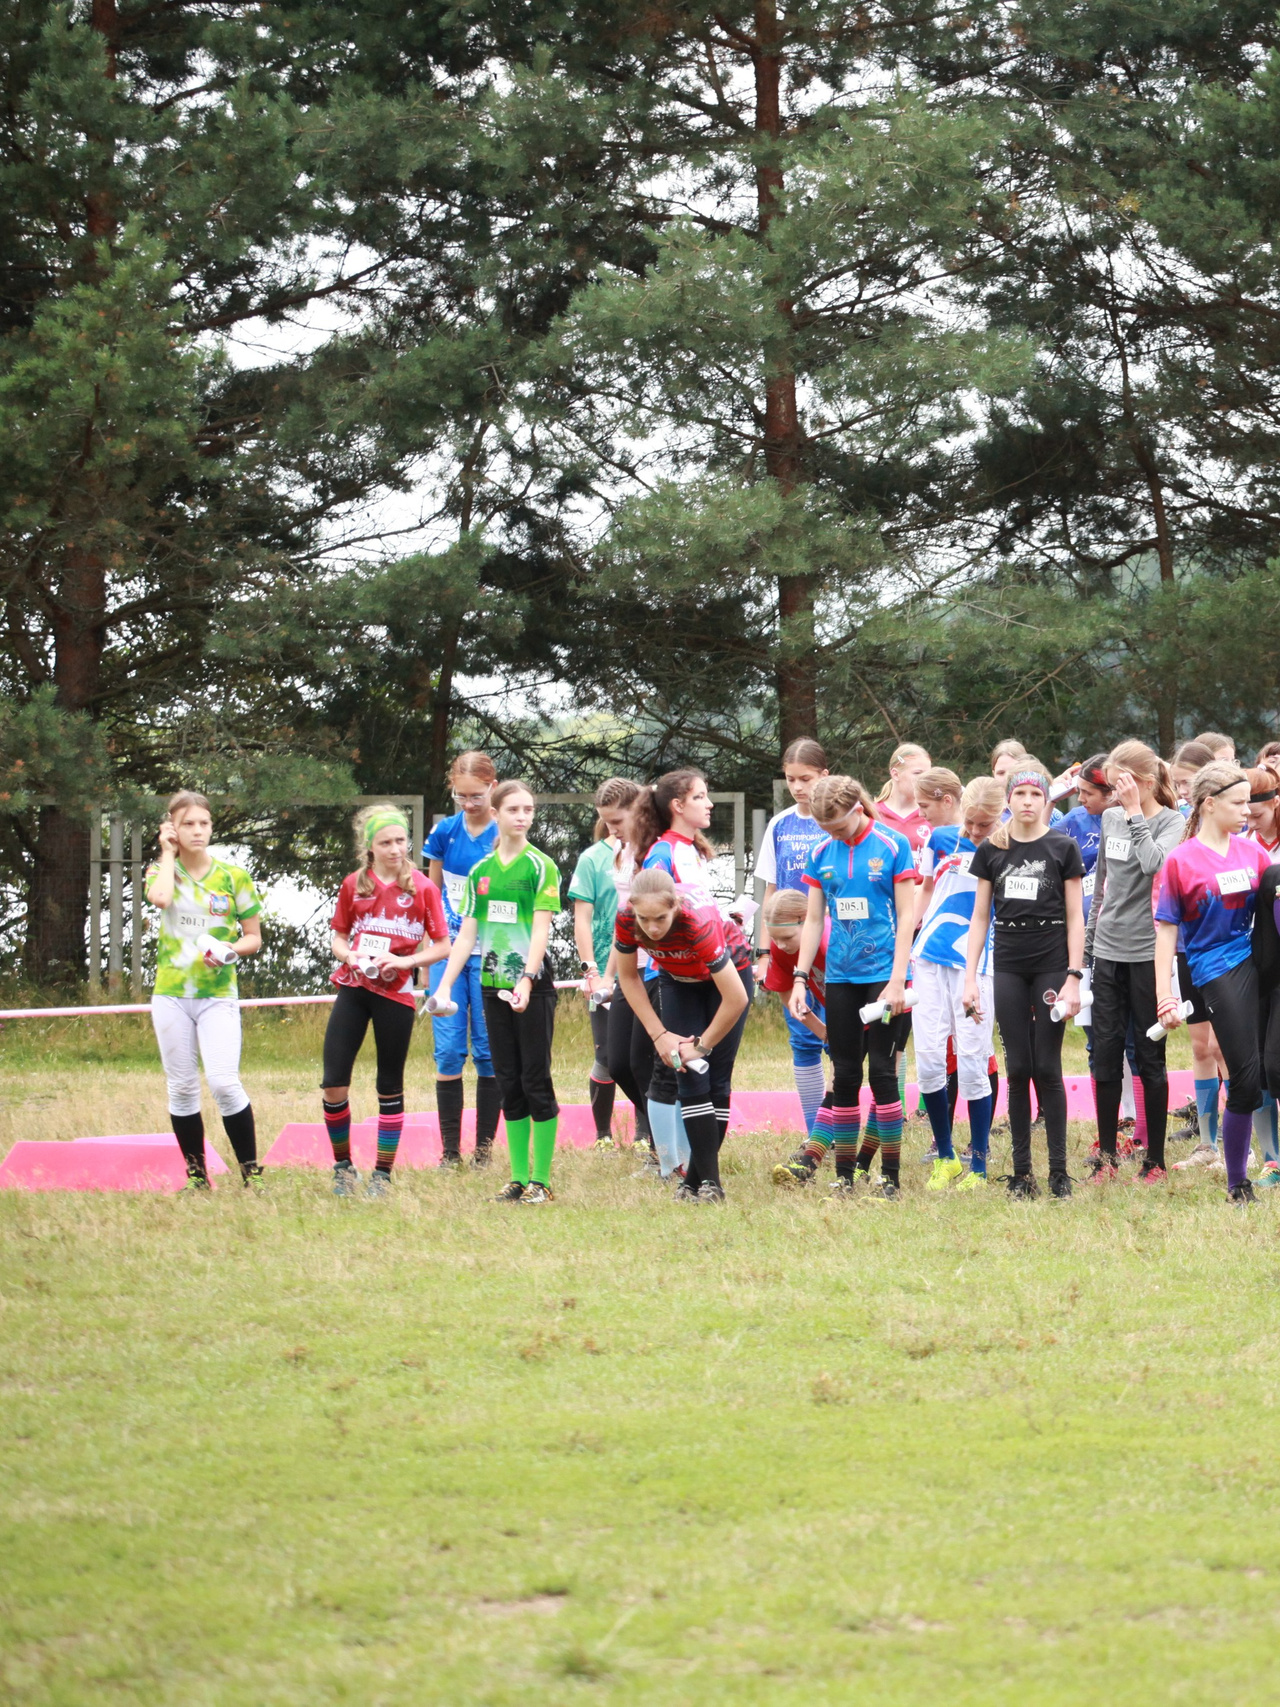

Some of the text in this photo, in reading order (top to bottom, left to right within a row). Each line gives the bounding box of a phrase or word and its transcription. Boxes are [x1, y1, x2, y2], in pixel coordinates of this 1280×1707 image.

[791, 841, 811, 853] Way
[1107, 841, 1127, 853] 215.1
[796, 851, 804, 860] of
[1221, 873, 1246, 886] 208.1
[1007, 880, 1034, 891] 206.1
[492, 904, 515, 915] 203.1
[840, 902, 865, 912] 205.1
[180, 916, 206, 927] 201.1
[363, 938, 387, 950] 202.1
